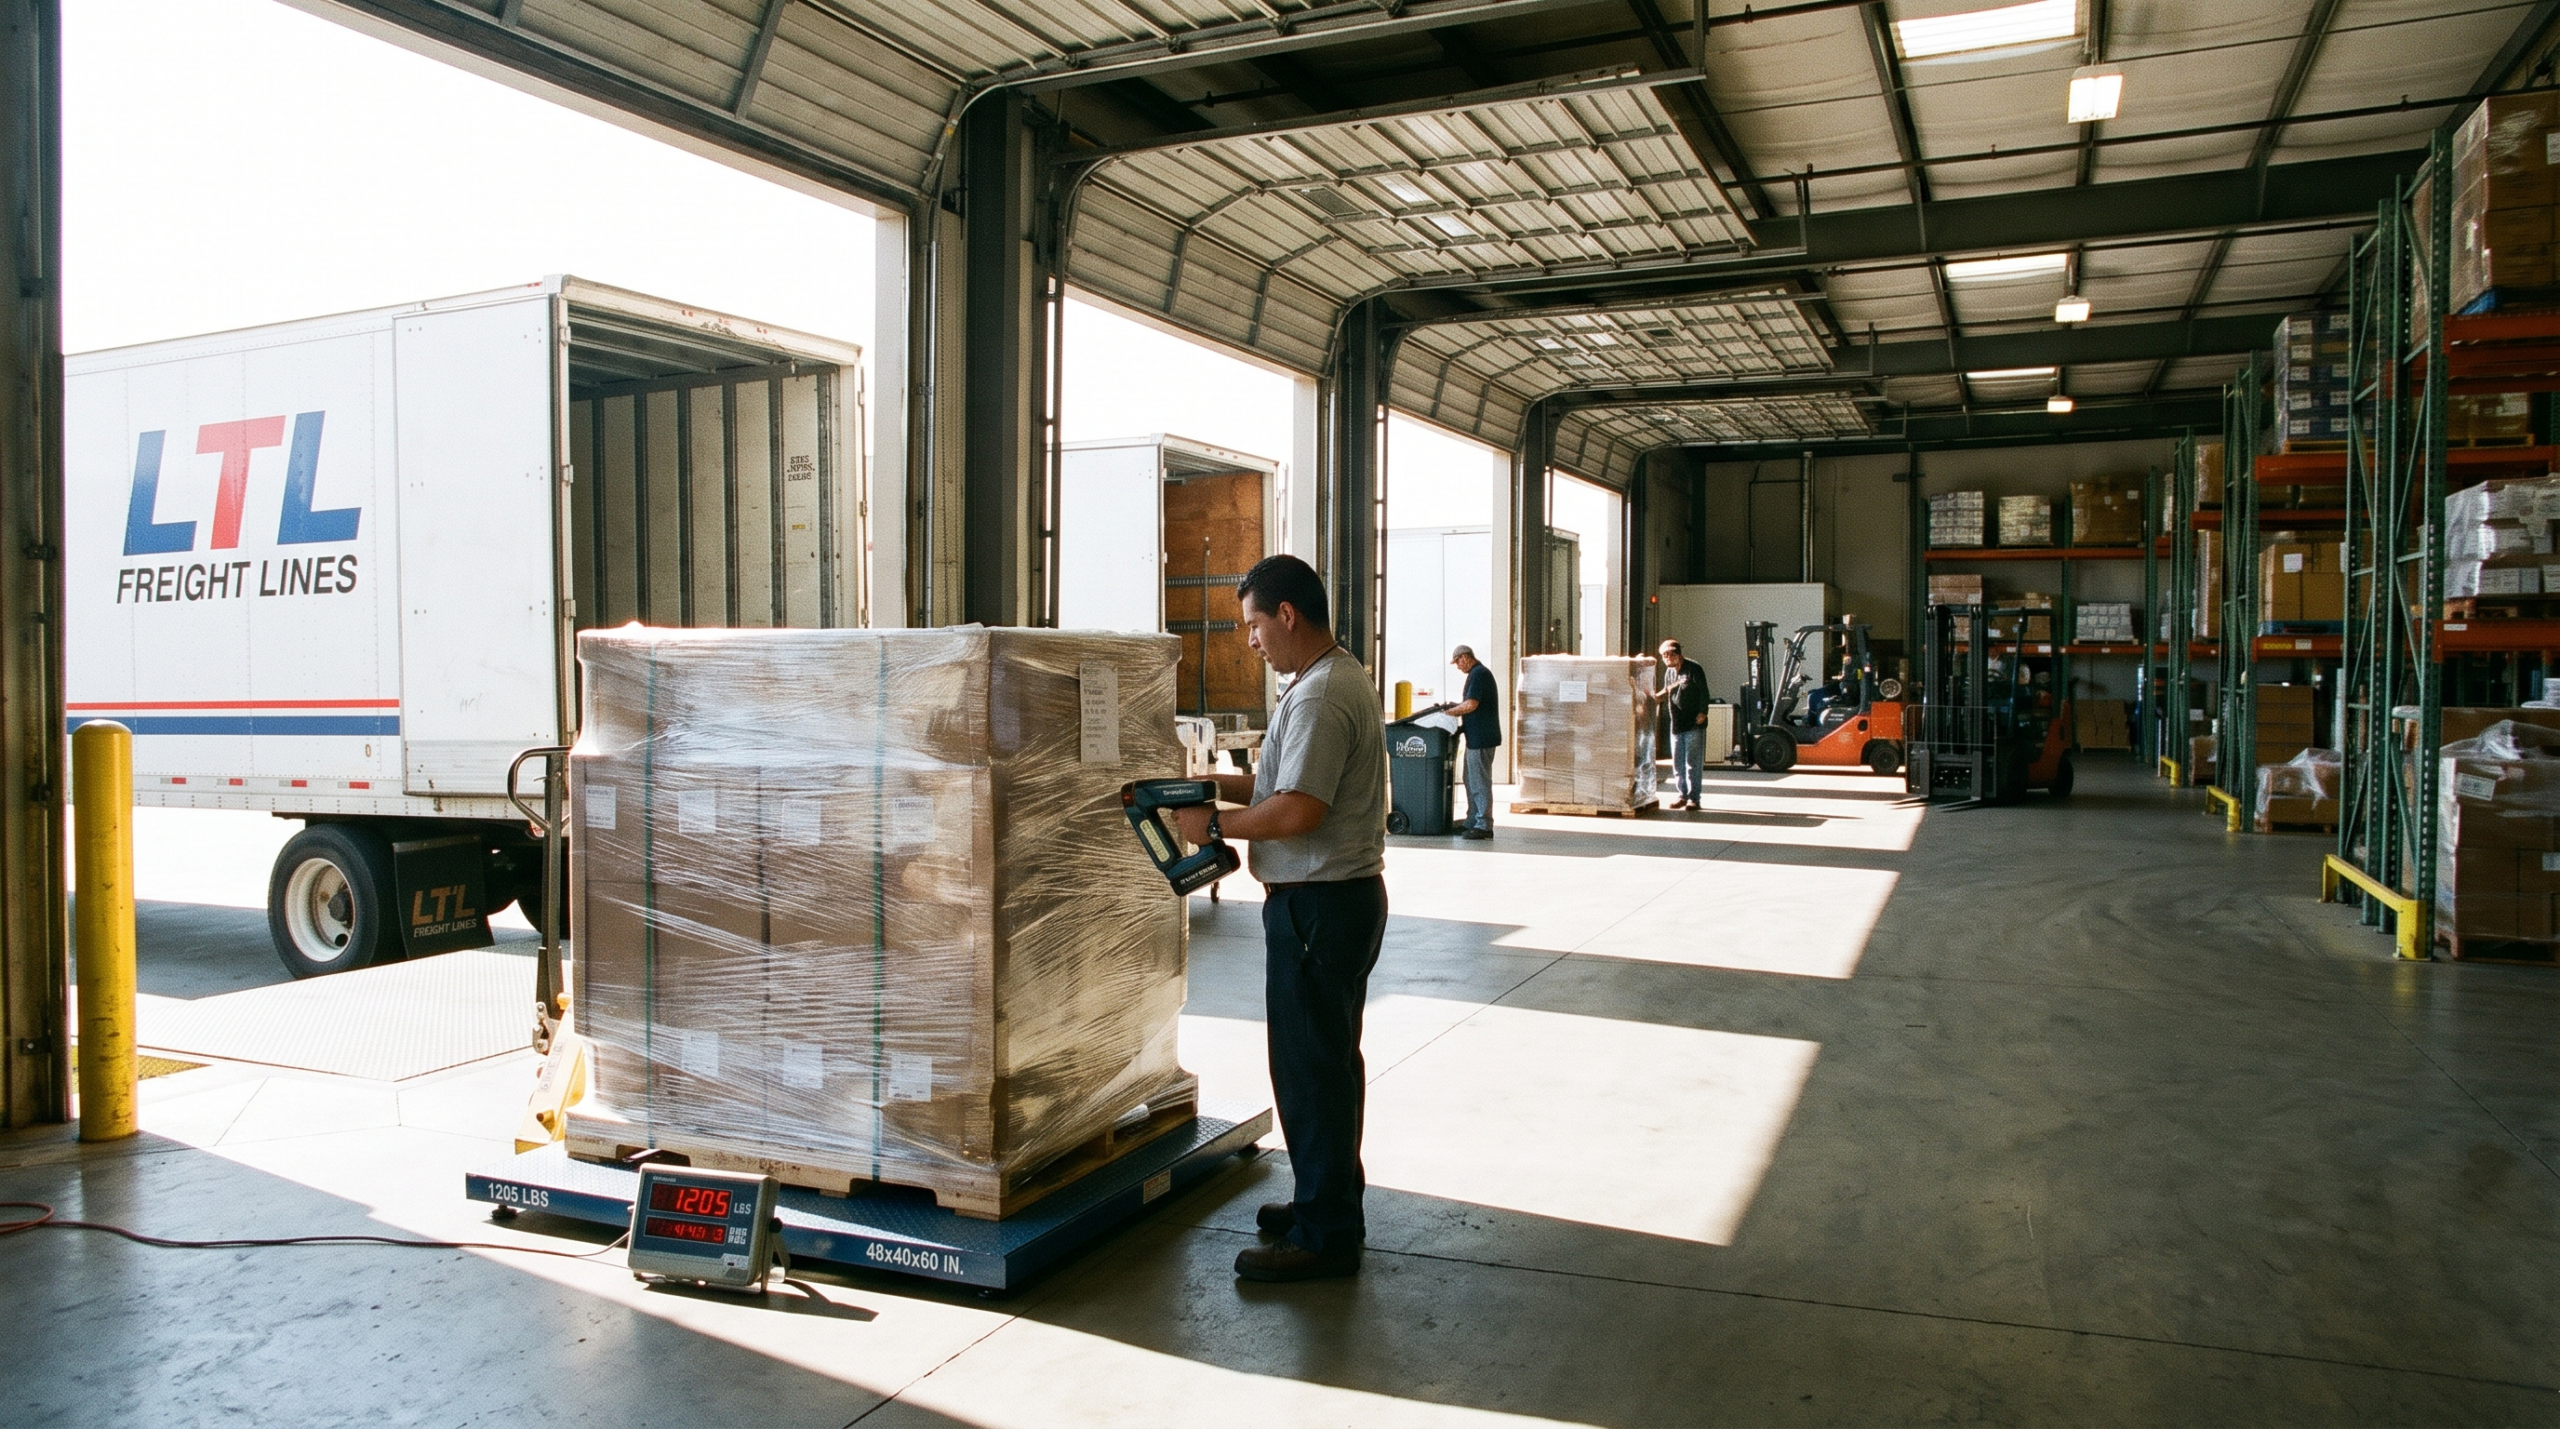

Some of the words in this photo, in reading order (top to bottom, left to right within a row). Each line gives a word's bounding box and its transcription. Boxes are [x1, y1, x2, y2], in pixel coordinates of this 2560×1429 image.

[123, 410, 362, 556] LTL
[117, 561, 251, 604] FREIGHT
[259, 554, 358, 597] LINES
[412, 885, 475, 926] LTL
[413, 922, 450, 938] FREIGHT
[451, 919, 477, 931] LINES
[488, 1182, 519, 1203] 1205
[522, 1187, 549, 1208] LBS
[676, 1188, 730, 1216] 1205
[866, 1242, 939, 1271] 48x40x60
[943, 1254, 964, 1276] IN.
